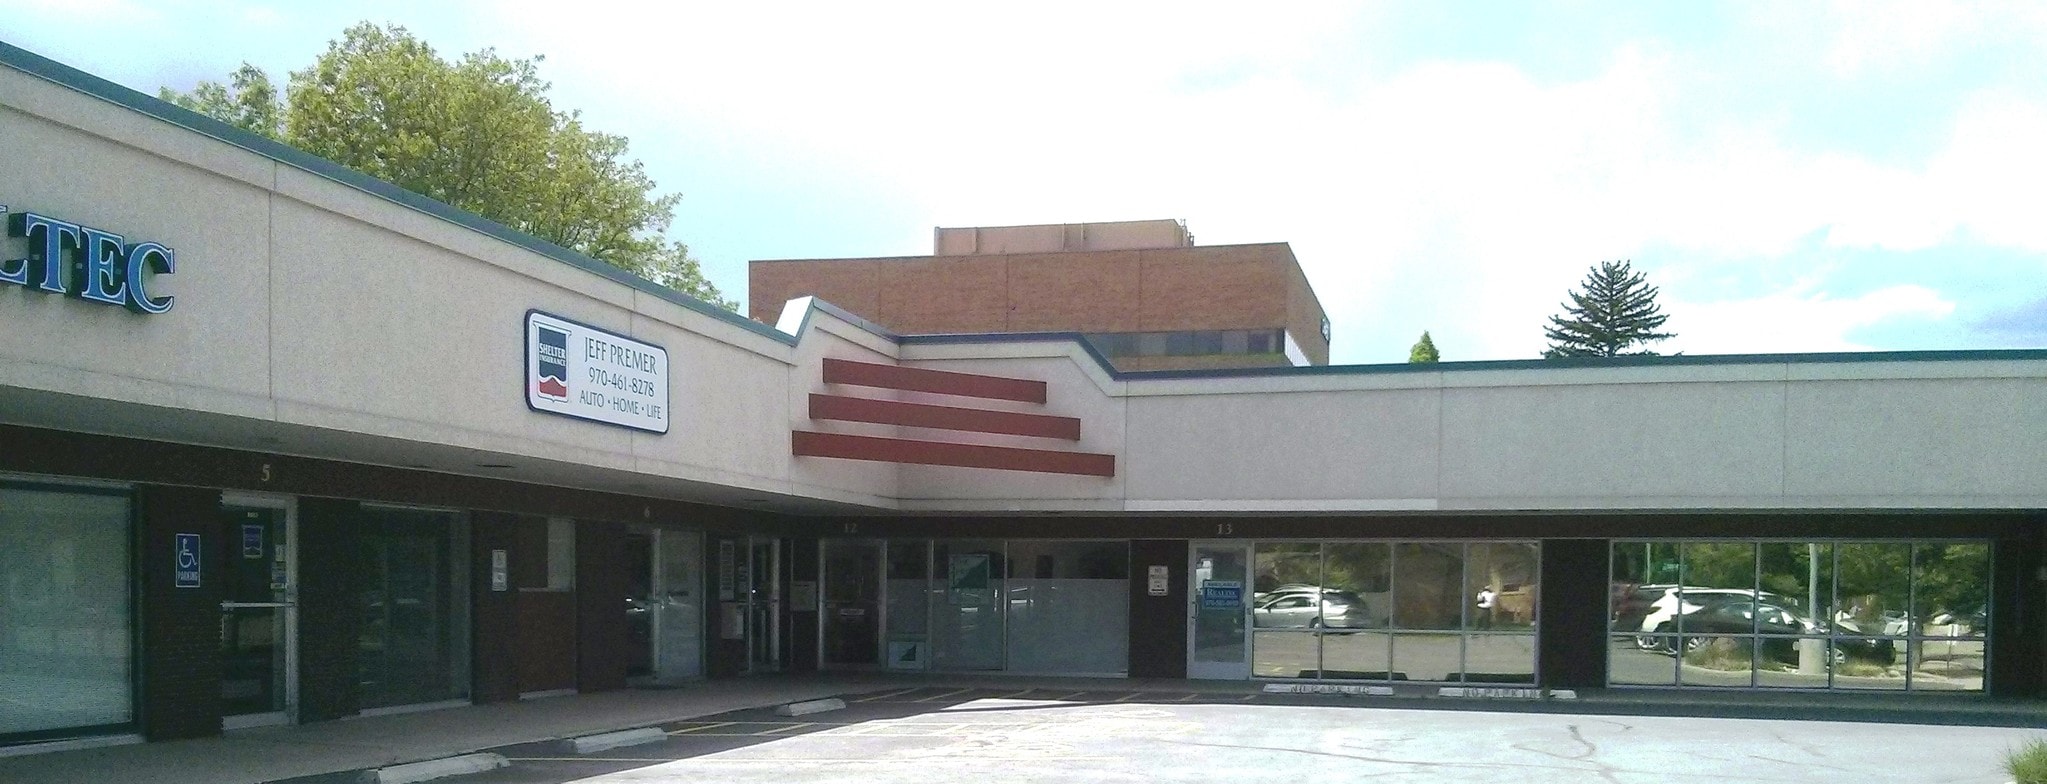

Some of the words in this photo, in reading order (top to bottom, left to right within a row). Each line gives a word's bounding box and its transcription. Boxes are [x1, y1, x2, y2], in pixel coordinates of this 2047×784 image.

[539, 342, 566, 359] SHELTER
[585, 337, 607, 362] JEFF
[610, 344, 658, 375] PREMER
[539, 354, 566, 367] INSURANCE
[589, 366, 655, 397] 970-461-8278
[580, 390, 605, 408] AUTO
[613, 397, 639, 415] HOME
[646, 404, 662, 420] LIFE
[261, 463, 271, 481] 5
[643, 505, 650, 518] 6
[844, 522, 858, 533] 12
[1217, 523, 1233, 535] 13
